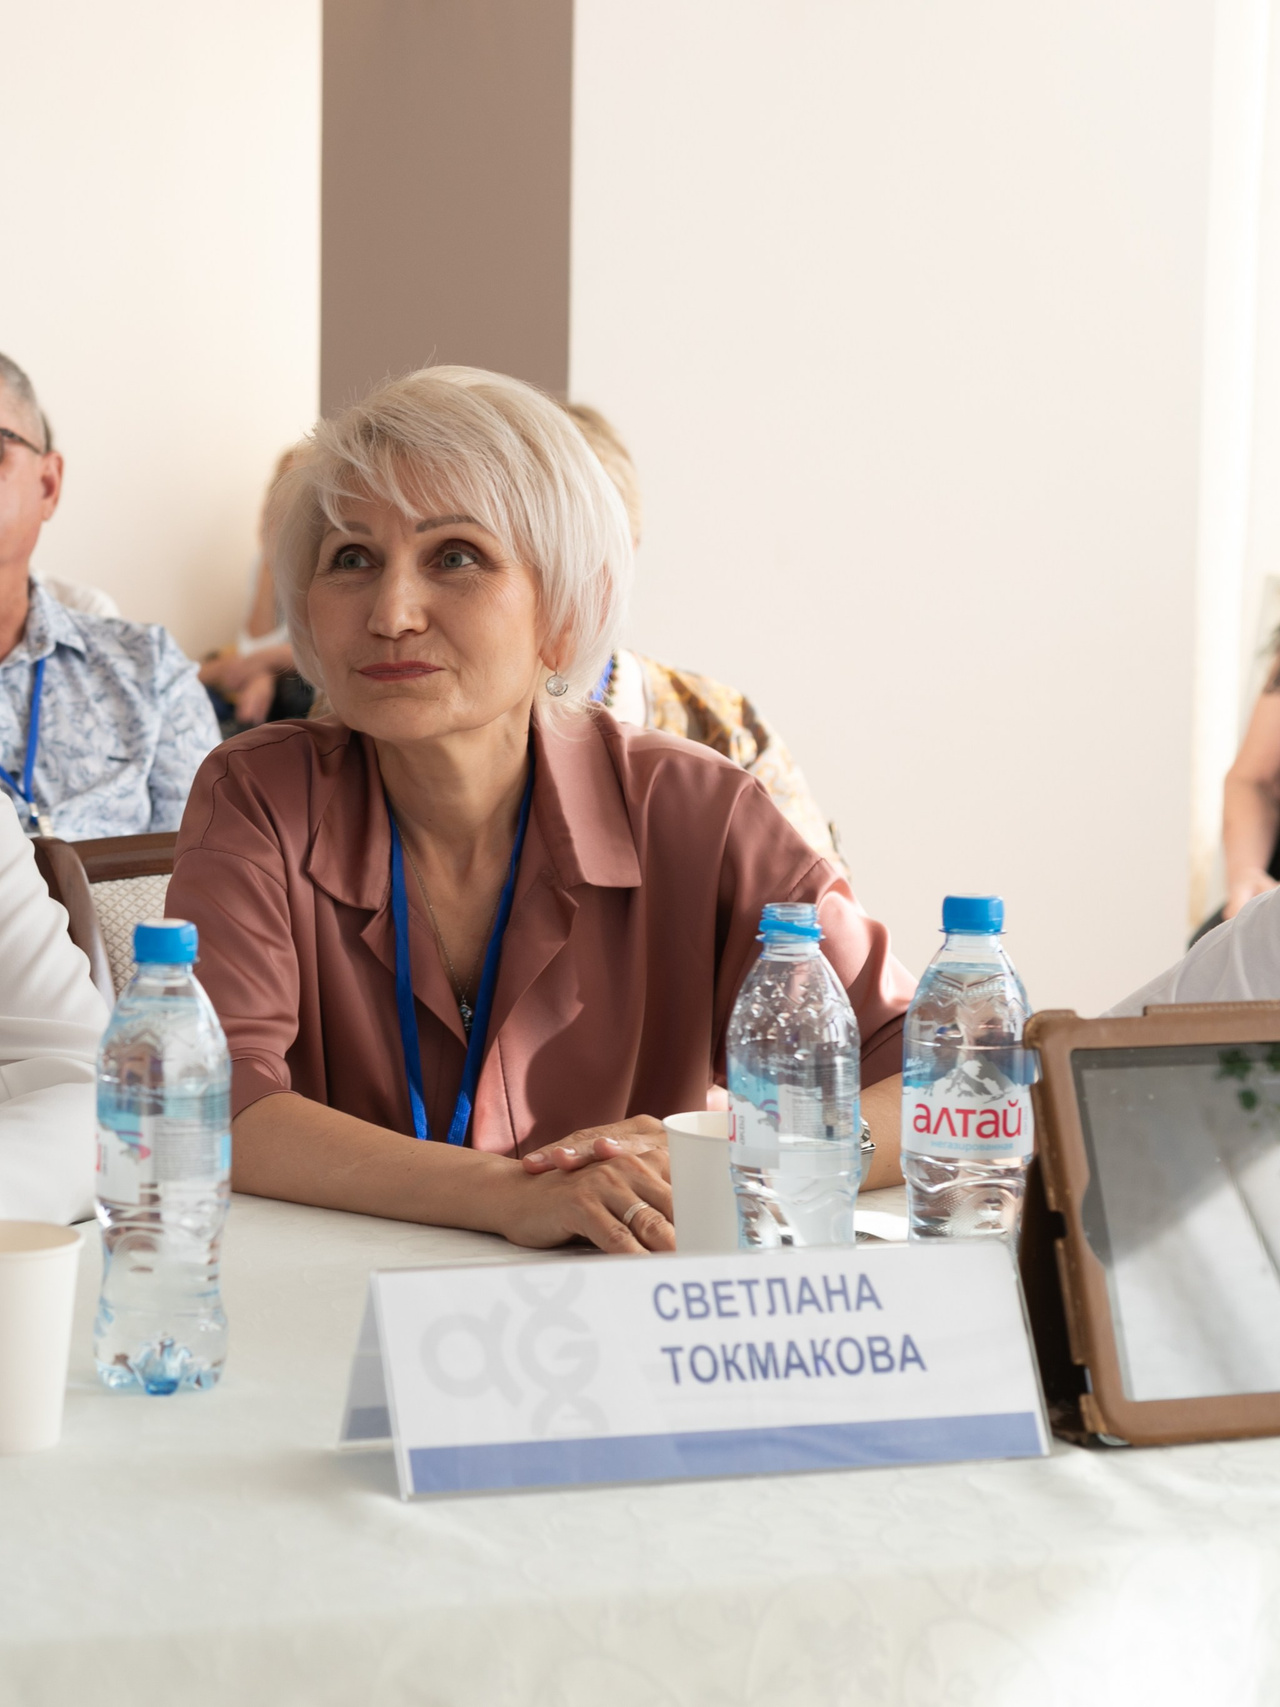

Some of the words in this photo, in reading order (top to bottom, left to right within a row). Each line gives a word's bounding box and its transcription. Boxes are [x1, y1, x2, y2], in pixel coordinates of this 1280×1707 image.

[913, 1099, 1022, 1139] алтай
[653, 1273, 883, 1321] СВЕТЛАНА
[661, 1333, 927, 1385] ТОКМАКОВА
